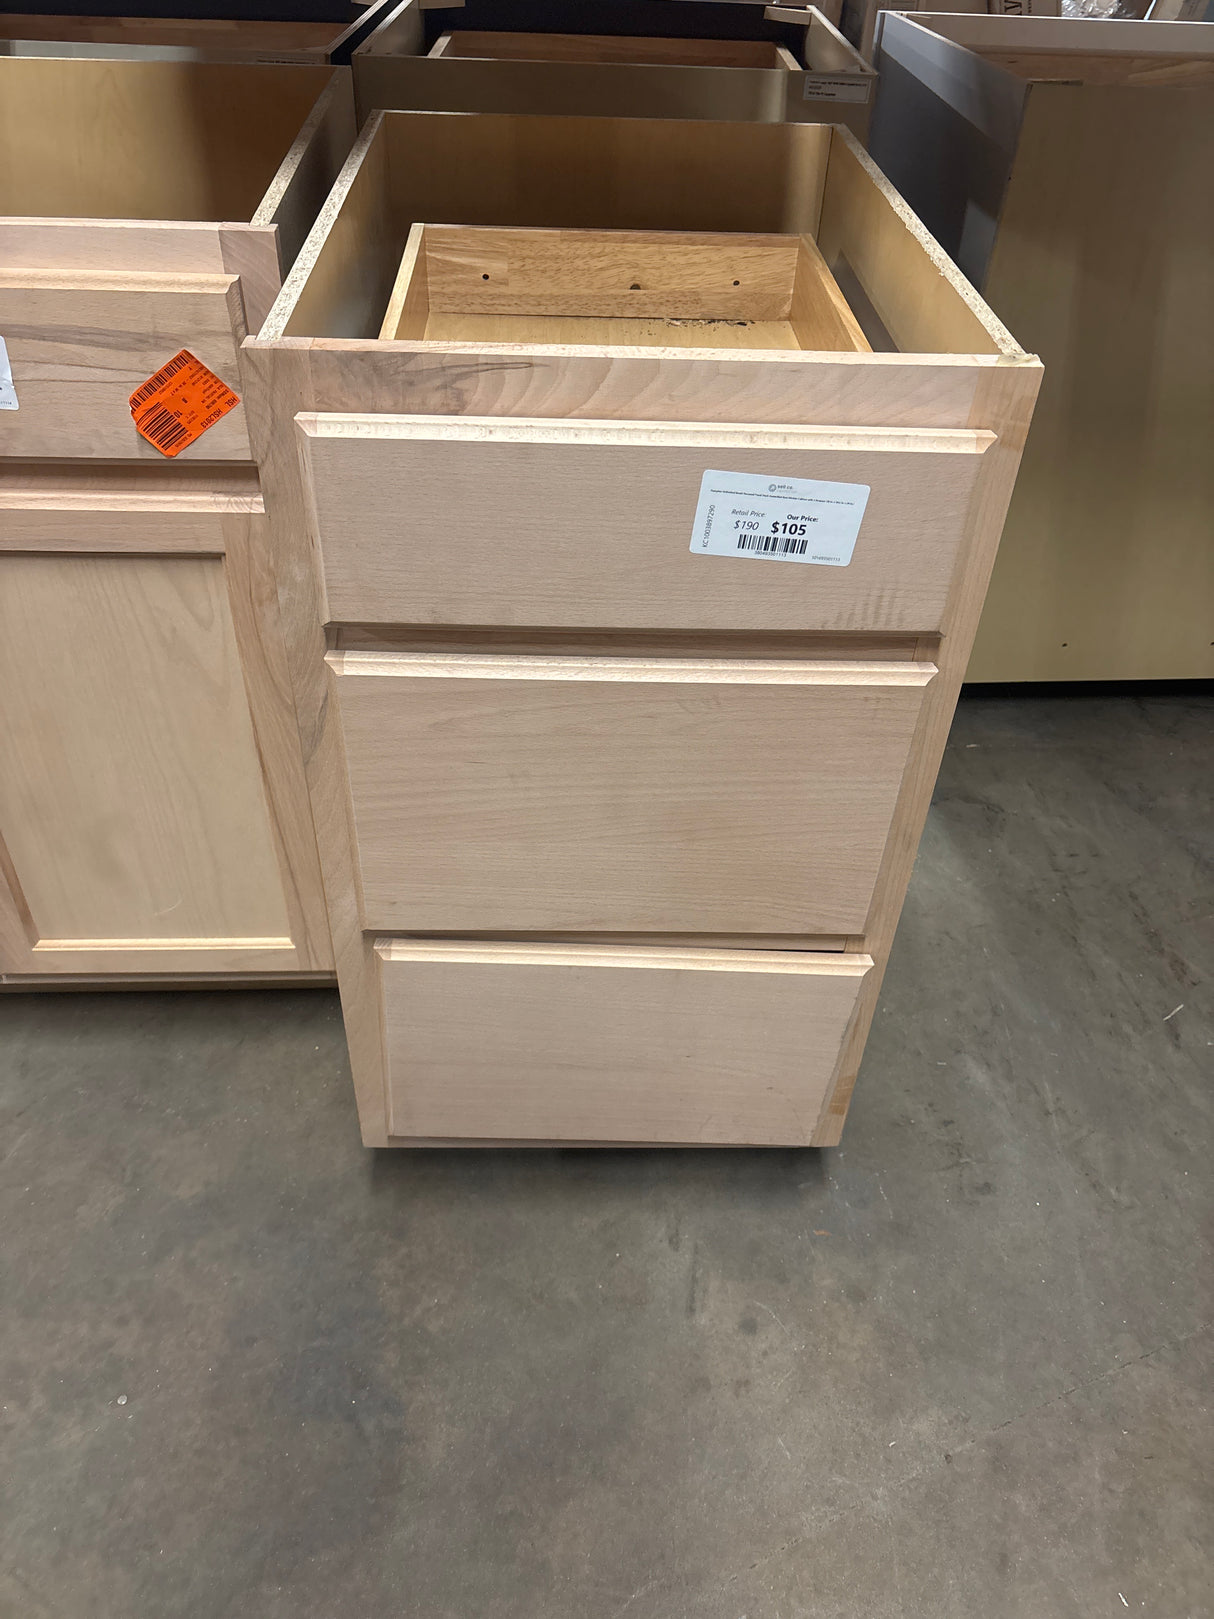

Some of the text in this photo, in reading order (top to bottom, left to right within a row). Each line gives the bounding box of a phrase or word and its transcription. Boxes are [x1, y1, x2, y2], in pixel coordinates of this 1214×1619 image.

[224, 396, 238, 408] HSL
[731, 508, 749, 517] Retail
[786, 513, 819, 523] Our Price:
[733, 519, 760, 531] $190
[770, 520, 808, 536] $105
